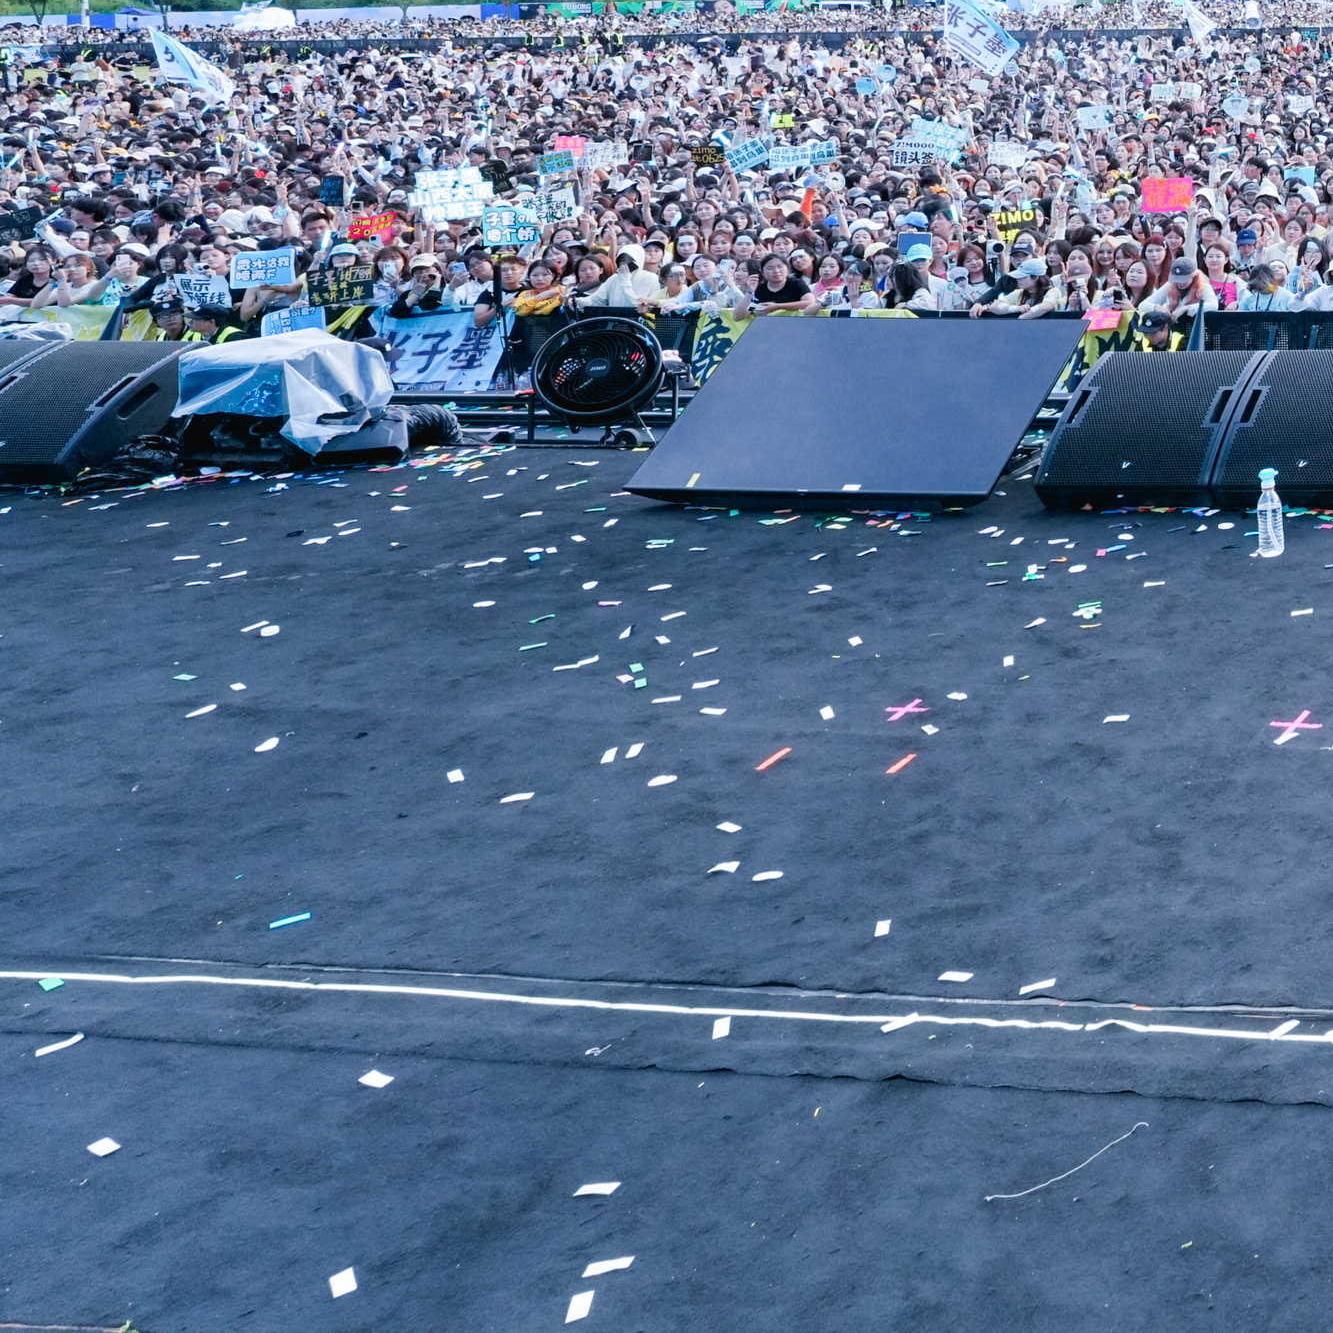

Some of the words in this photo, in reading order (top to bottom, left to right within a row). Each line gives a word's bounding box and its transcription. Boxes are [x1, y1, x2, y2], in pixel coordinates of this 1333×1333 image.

[946, 2, 1008, 59] 张子墨
[416, 168, 479, 189] 张子墨
[408, 184, 495, 207] 山西太原
[180, 278, 211, 292] 展示
